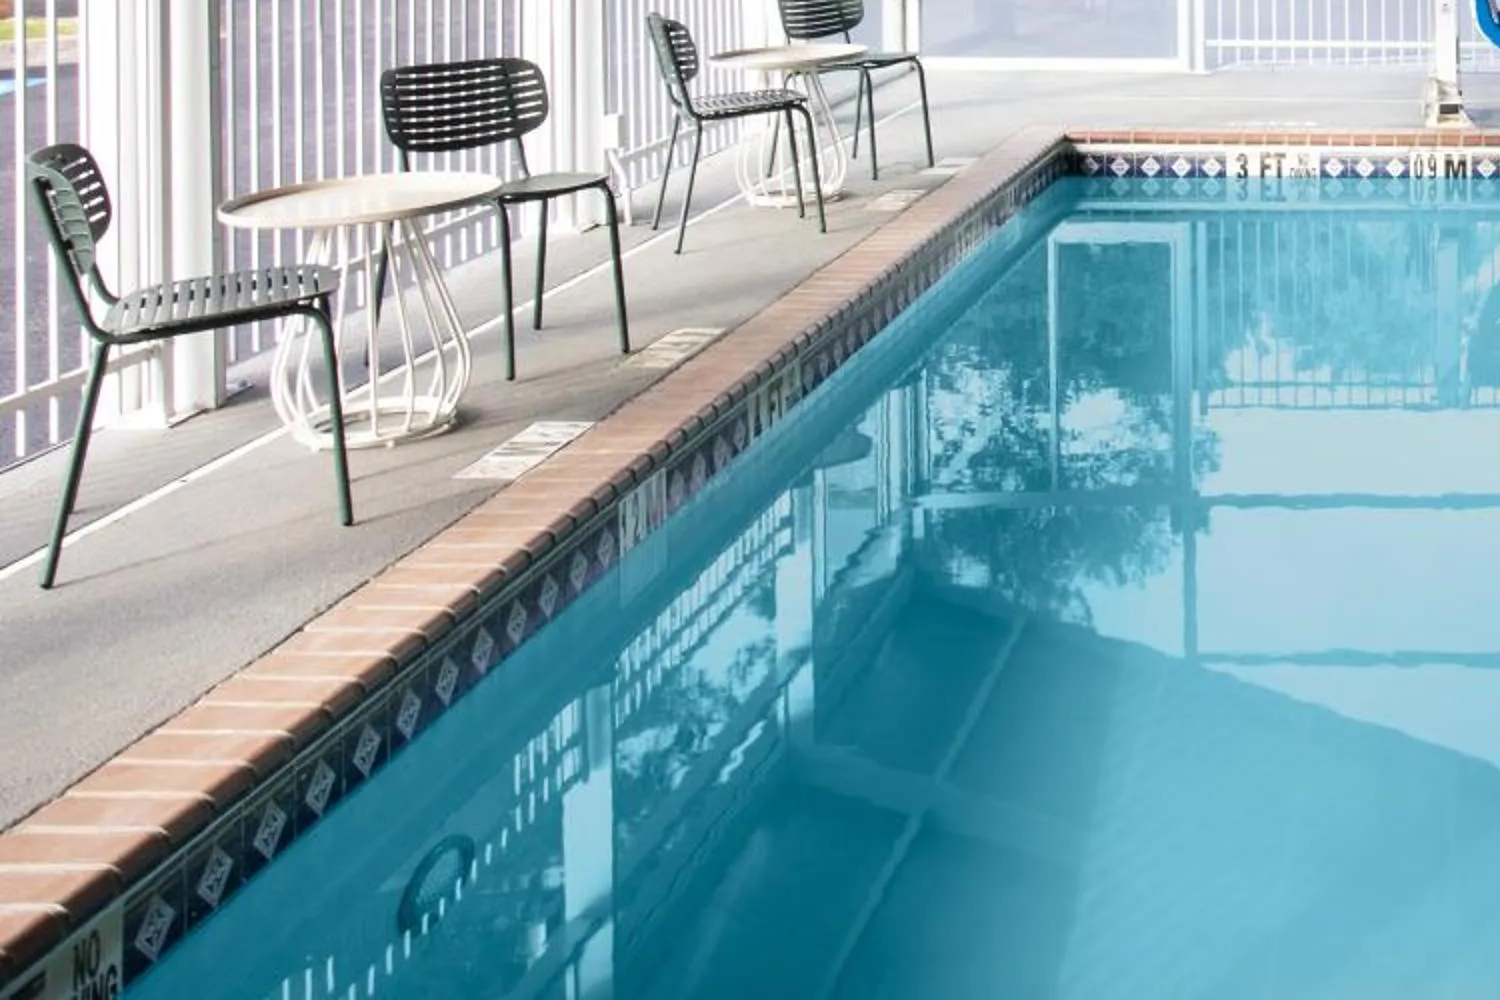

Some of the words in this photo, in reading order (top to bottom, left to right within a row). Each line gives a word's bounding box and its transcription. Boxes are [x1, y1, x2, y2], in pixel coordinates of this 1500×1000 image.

[1236, 153, 1249, 179] 3
[1260, 152, 1286, 179] FT
[1445, 153, 1467, 180] M
[72, 929, 101, 993] NO
